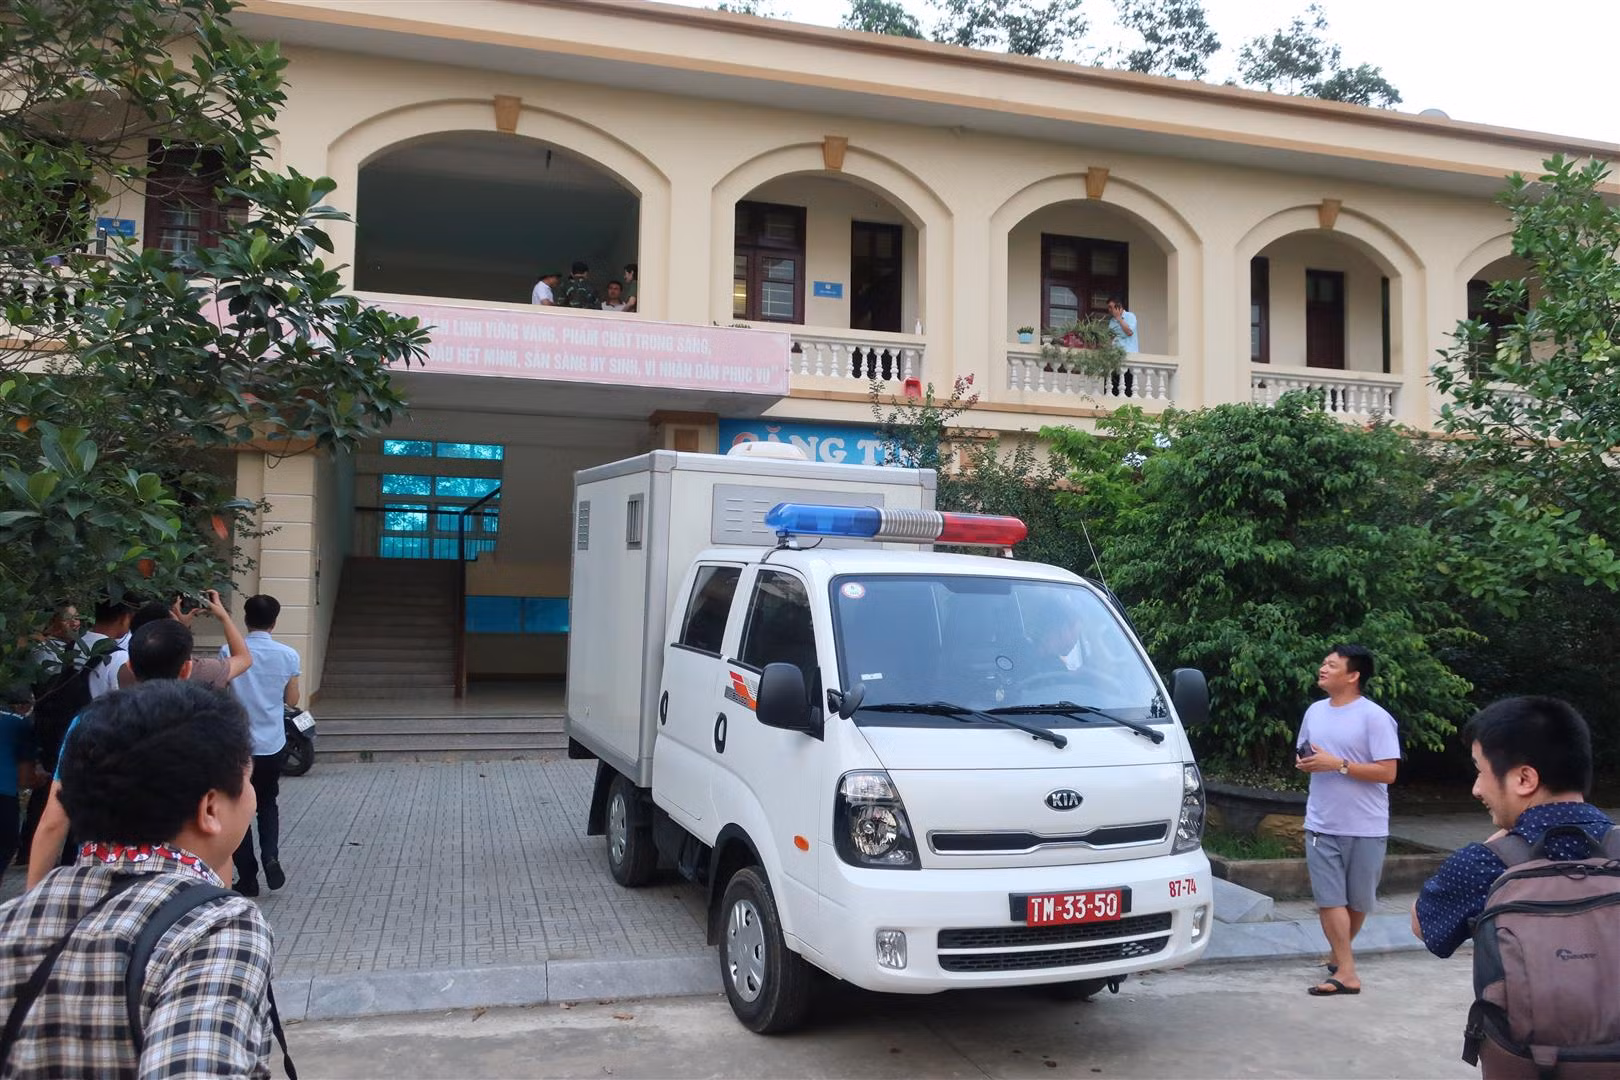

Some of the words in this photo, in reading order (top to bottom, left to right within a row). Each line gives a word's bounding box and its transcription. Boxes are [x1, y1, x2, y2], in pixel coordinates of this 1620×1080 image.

[1052, 793, 1079, 807] KIA
[1169, 879, 1197, 897] 87-74
[1031, 893, 1118, 922] TM-33-50
